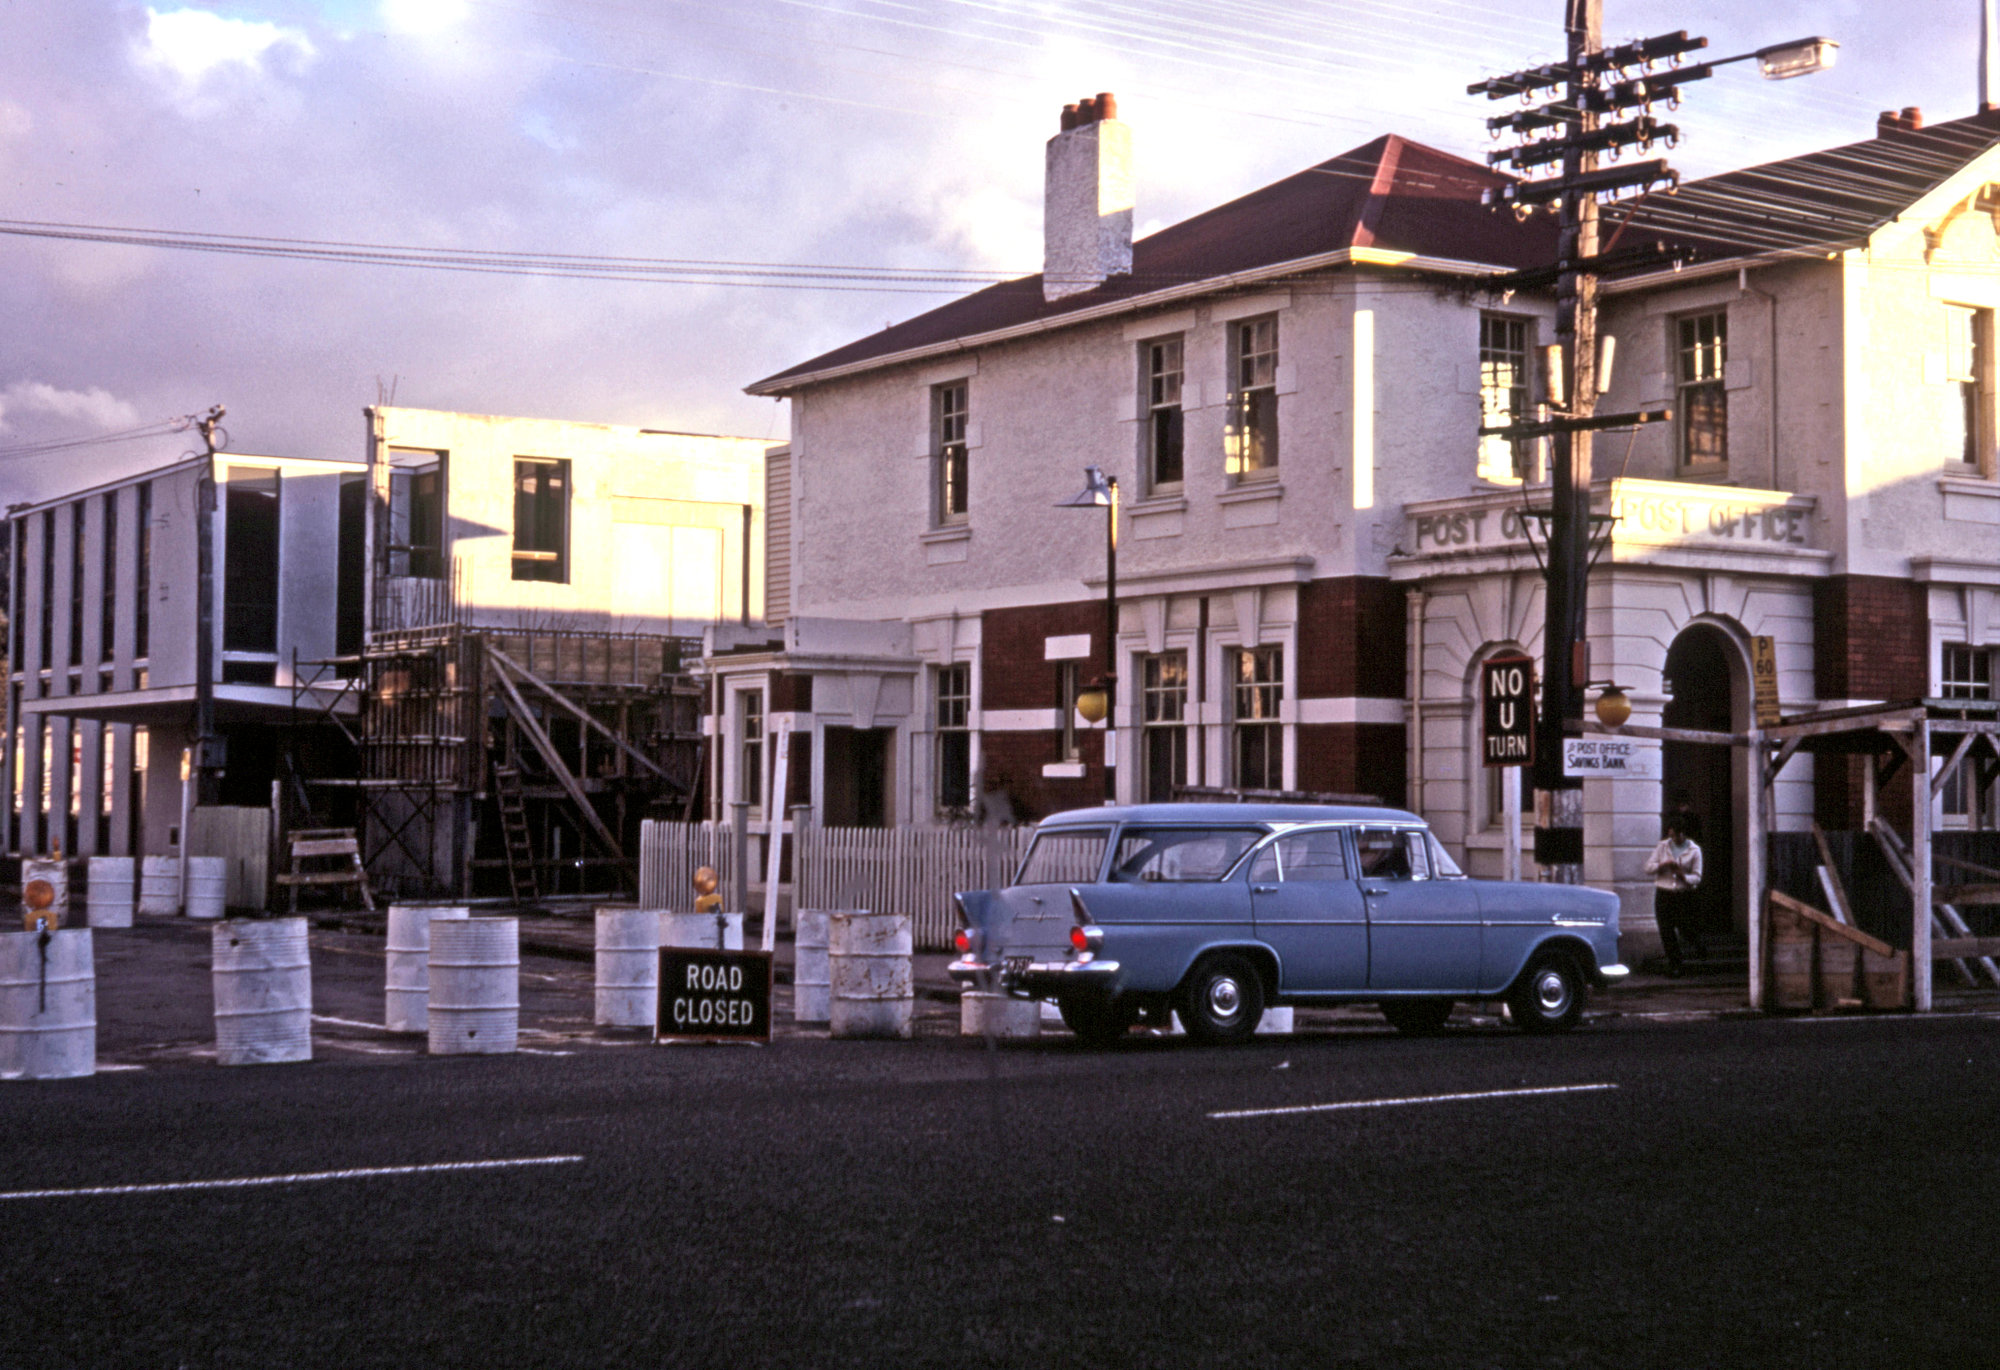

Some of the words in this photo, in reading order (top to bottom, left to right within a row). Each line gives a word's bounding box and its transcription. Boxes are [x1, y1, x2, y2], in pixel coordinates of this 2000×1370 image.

[1416, 509, 1488, 549] POST
[1621, 498, 1694, 534] POST
[1708, 503, 1804, 543] OFFICE
[1758, 635, 1769, 657] P
[1756, 659, 1773, 675] 60
[1491, 668, 1523, 697] NO
[1500, 702, 1515, 729] U
[1488, 735, 1527, 757] TURN
[1577, 742, 1597, 754] POST
[1599, 743, 1631, 755] OFFICE
[687, 964, 742, 990] ROAD
[674, 998, 753, 1024] CLOSED
